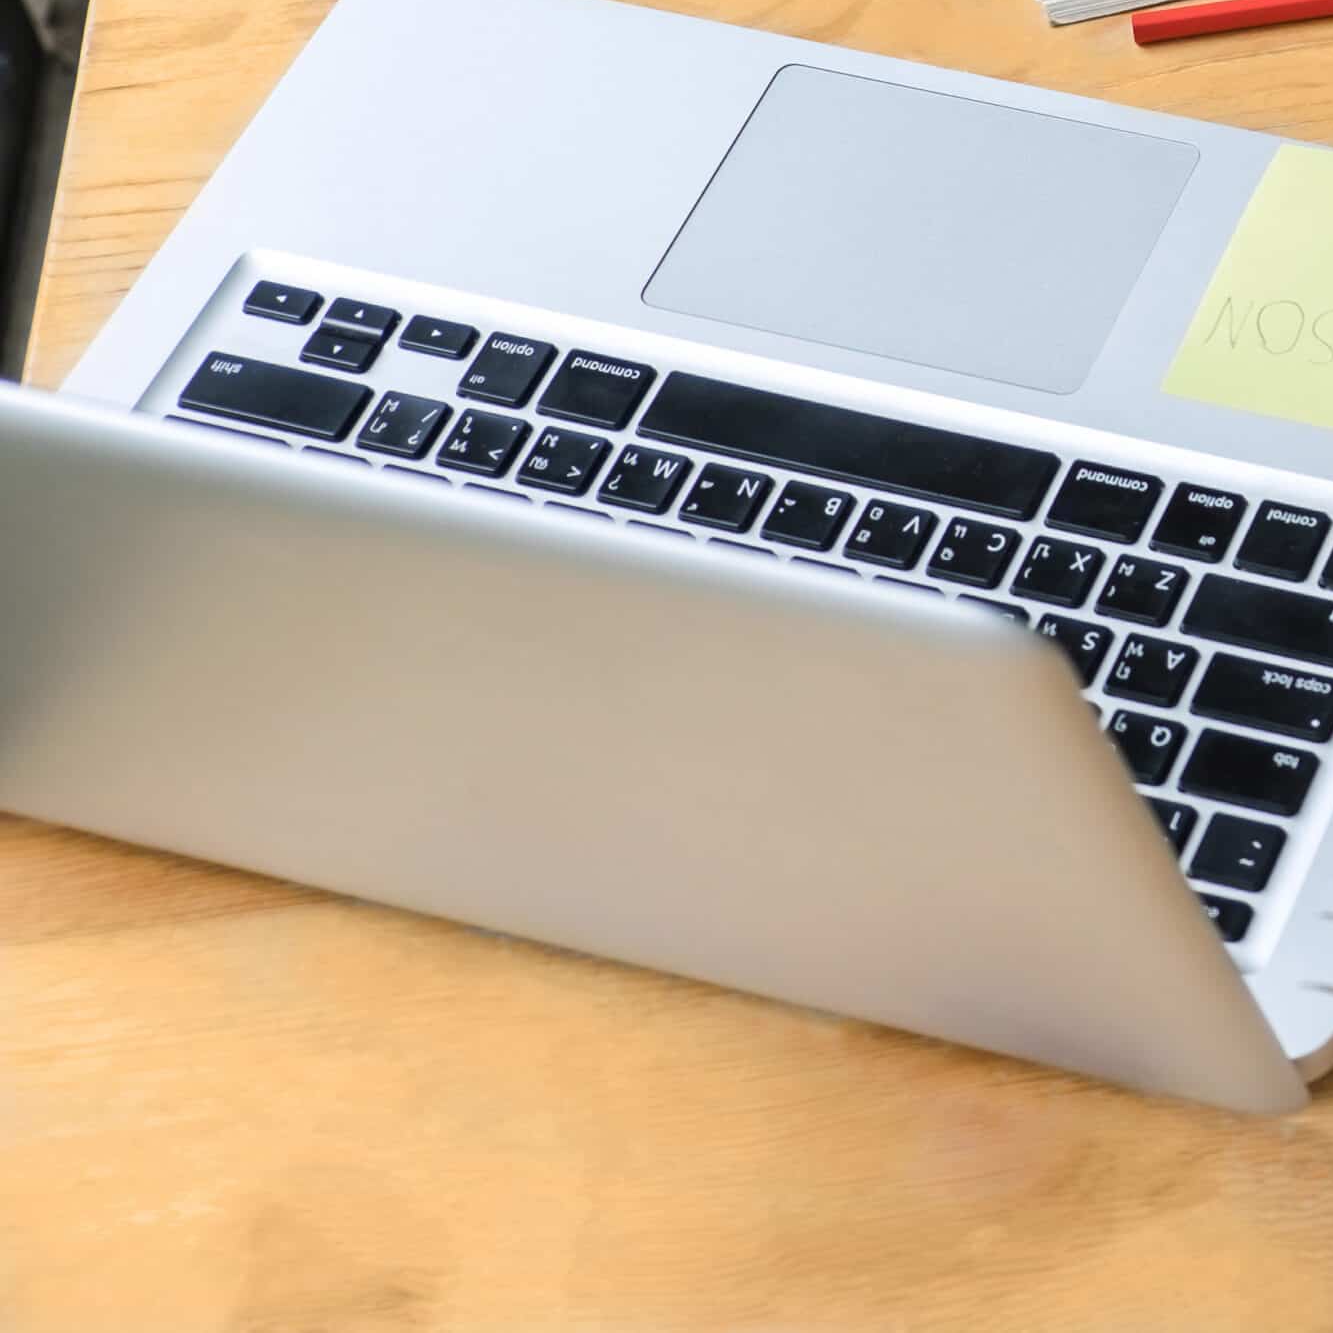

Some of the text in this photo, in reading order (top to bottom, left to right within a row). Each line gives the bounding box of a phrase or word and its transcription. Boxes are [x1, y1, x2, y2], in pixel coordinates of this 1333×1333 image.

[491, 338, 535, 356] option
[209, 359, 241, 374] shift
[571, 356, 641, 379] command
[468, 373, 485, 384] alt
[653, 458, 679, 479] M
[737, 479, 760, 499] N
[1076, 468, 1149, 492] command
[824, 498, 843, 516] B
[1188, 491, 1234, 510] option
[902, 516, 920, 535] V
[1266, 508, 1318, 527] control
[987, 533, 1006, 552] C
[1069, 551, 1092, 573] X
[1155, 571, 1177, 591] Z
[1081, 631, 1100, 651] S
[1167, 649, 1185, 670] A
[1263, 670, 1332, 694] caps lock
[1151, 725, 1172, 746] Q
[1273, 751, 1300, 769] tab
[1169, 811, 1181, 831] 1
